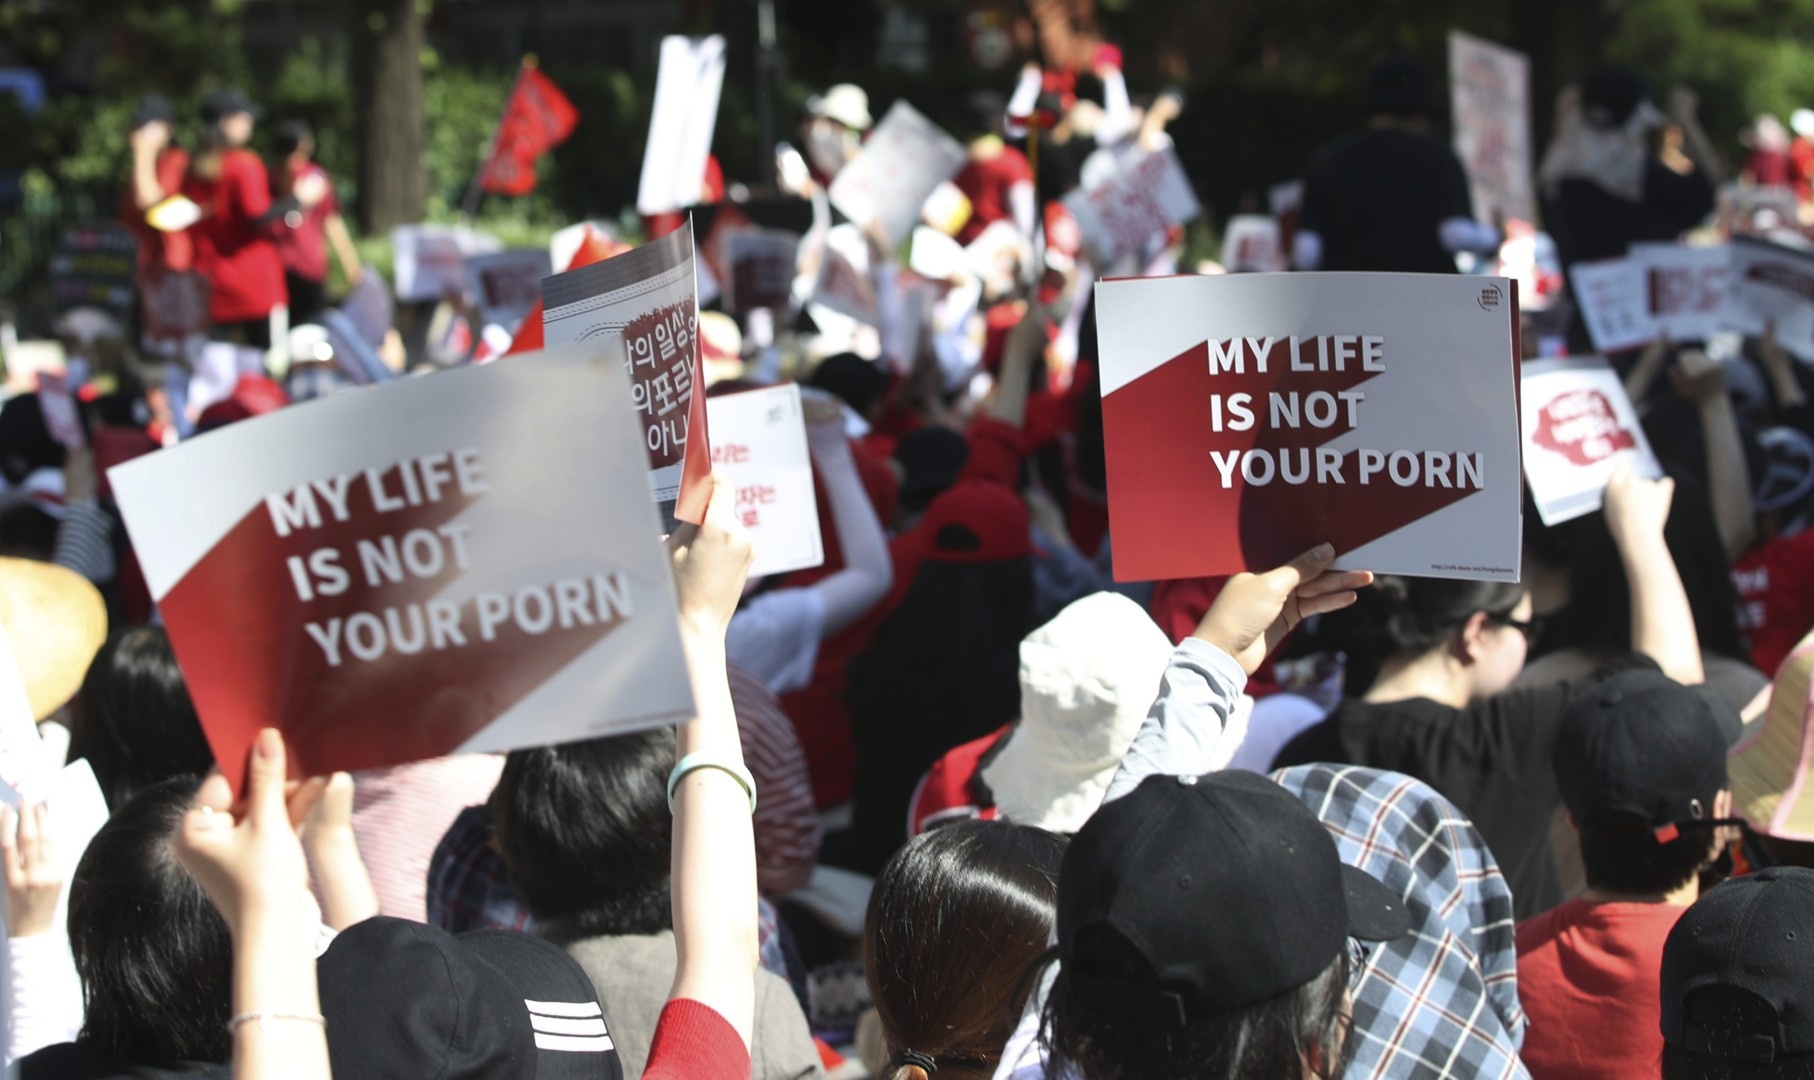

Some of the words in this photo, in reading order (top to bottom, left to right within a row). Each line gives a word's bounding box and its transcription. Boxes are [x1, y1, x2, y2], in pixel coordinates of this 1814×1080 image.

[1206, 336, 1275, 375] MY
[1289, 335, 1386, 372] LIFE
[1210, 392, 1256, 432] IS
[1268, 390, 1366, 429] NOT
[264, 473, 351, 537] MY
[364, 448, 491, 512] LIFE
[1209, 447, 1347, 488] YOUR
[1358, 448, 1485, 489] PORN
[287, 547, 351, 601] IS
[356, 523, 474, 587] NOT
[304, 598, 468, 667] YOUR
[475, 572, 635, 641] PORN
